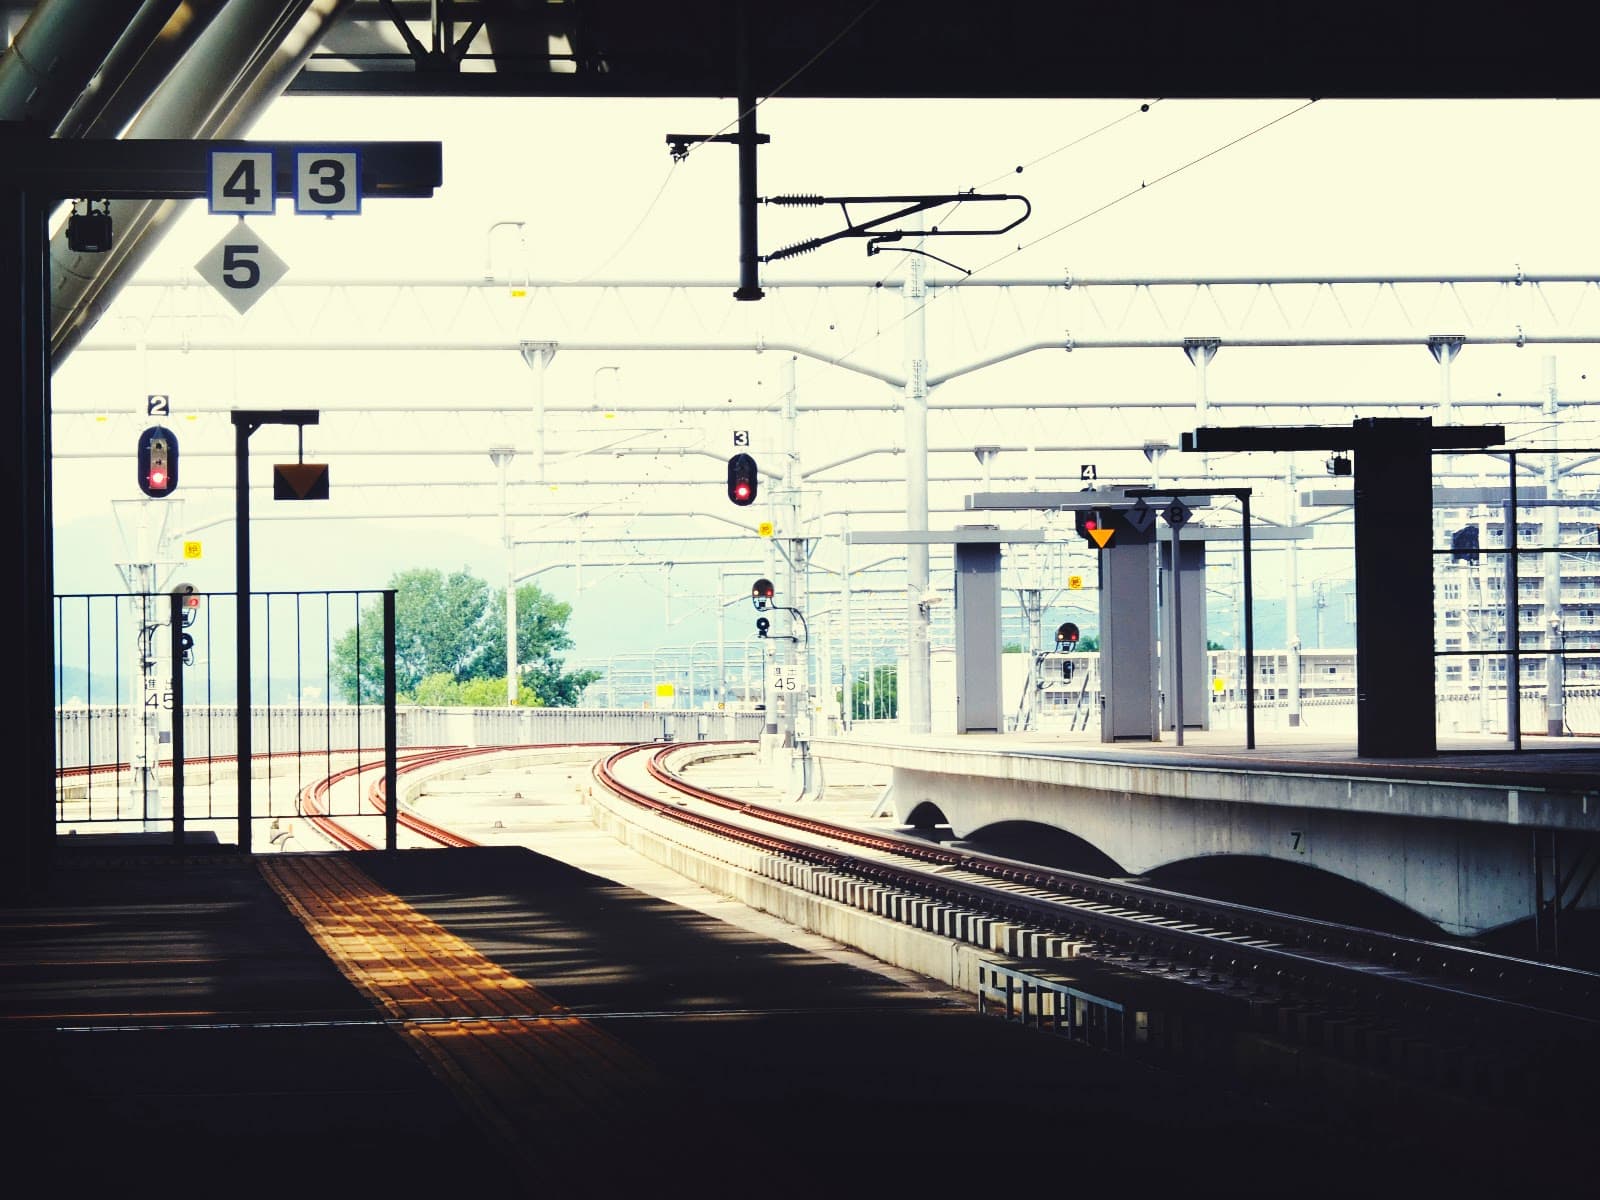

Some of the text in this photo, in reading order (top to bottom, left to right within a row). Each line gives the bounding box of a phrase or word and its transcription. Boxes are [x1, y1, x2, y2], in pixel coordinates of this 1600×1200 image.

[223, 159, 261, 205] 4
[308, 159, 346, 204] 3
[223, 245, 260, 289] 5
[150, 396, 168, 416] 2
[735, 431, 747, 446] 3
[1083, 465, 1095, 480] 4
[1134, 508, 1147, 524] 7
[1170, 506, 1183, 523] 8
[774, 677, 796, 690] 45
[145, 693, 174, 710] 45
[1290, 831, 1303, 851] 7
